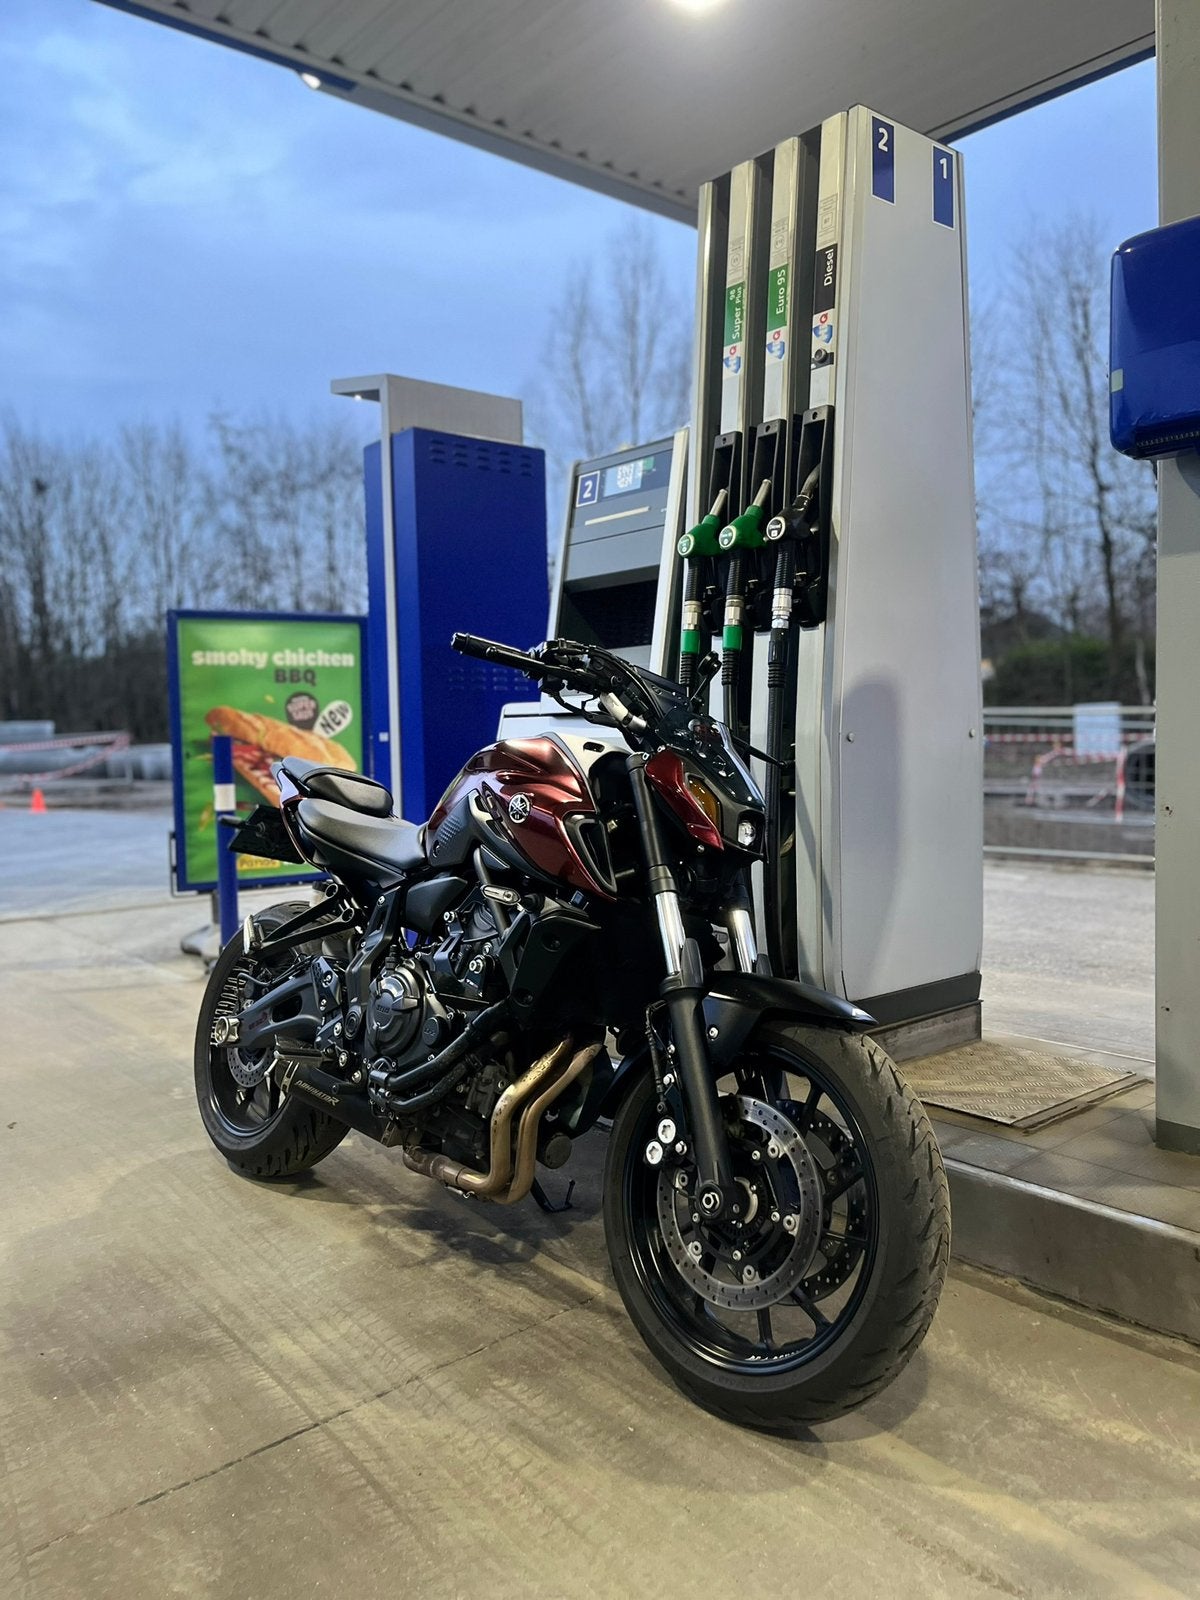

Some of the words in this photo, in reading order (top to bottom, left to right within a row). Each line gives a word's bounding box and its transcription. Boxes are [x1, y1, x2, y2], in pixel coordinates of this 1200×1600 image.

[878, 127, 888, 152] 2
[939, 157, 948, 180] 1
[776, 269, 787, 285] 95
[824, 249, 834, 286] Diesel
[729, 288, 737, 301] 98
[735, 286, 743, 304] Plus
[775, 287, 786, 315] Euro
[731, 306, 742, 340] Super
[582, 479, 593, 499] 2
[193, 649, 268, 668] smoky
[273, 648, 354, 667] chicken
[275, 669, 316, 685] BBQ
